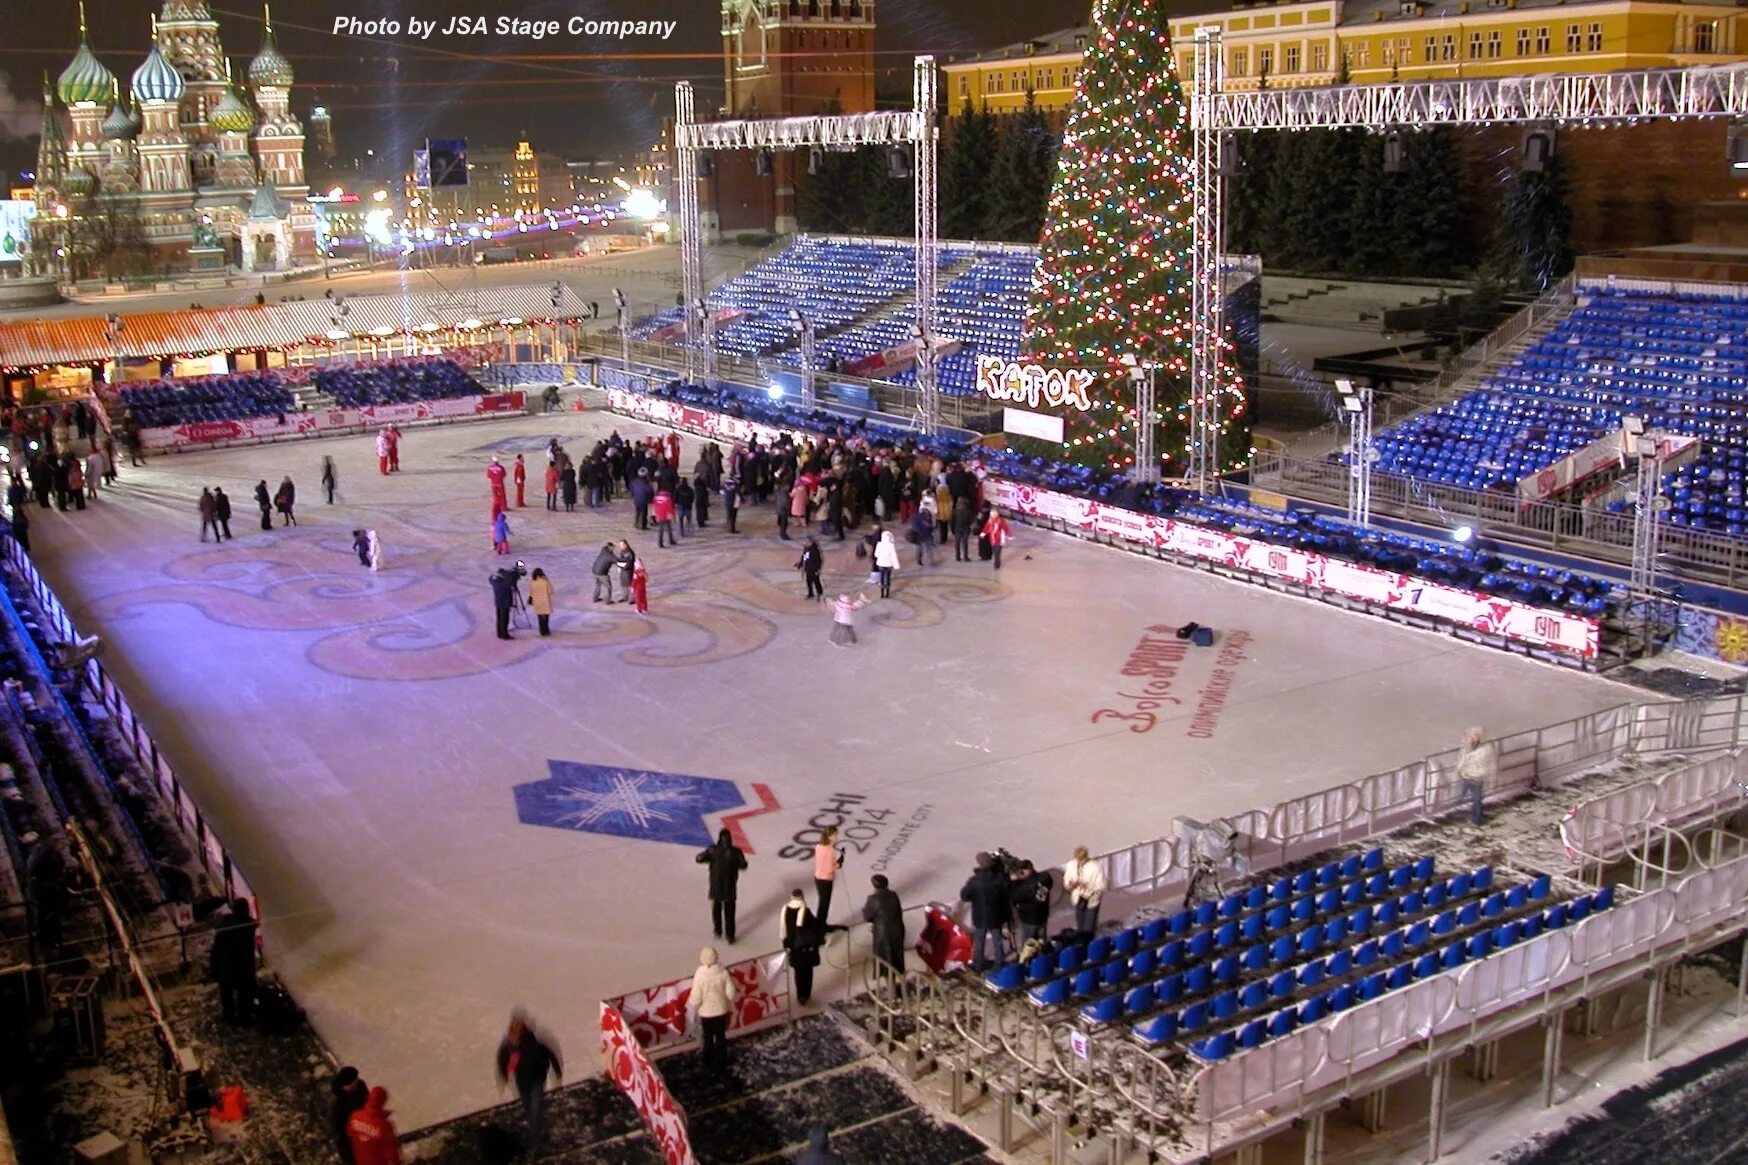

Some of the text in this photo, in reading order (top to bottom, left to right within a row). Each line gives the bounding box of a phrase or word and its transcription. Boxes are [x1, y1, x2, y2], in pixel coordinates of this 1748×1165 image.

[777, 792, 868, 862] SOCHI
[834, 807, 897, 854] 2014
[871, 821, 921, 872] CANDIDATE
